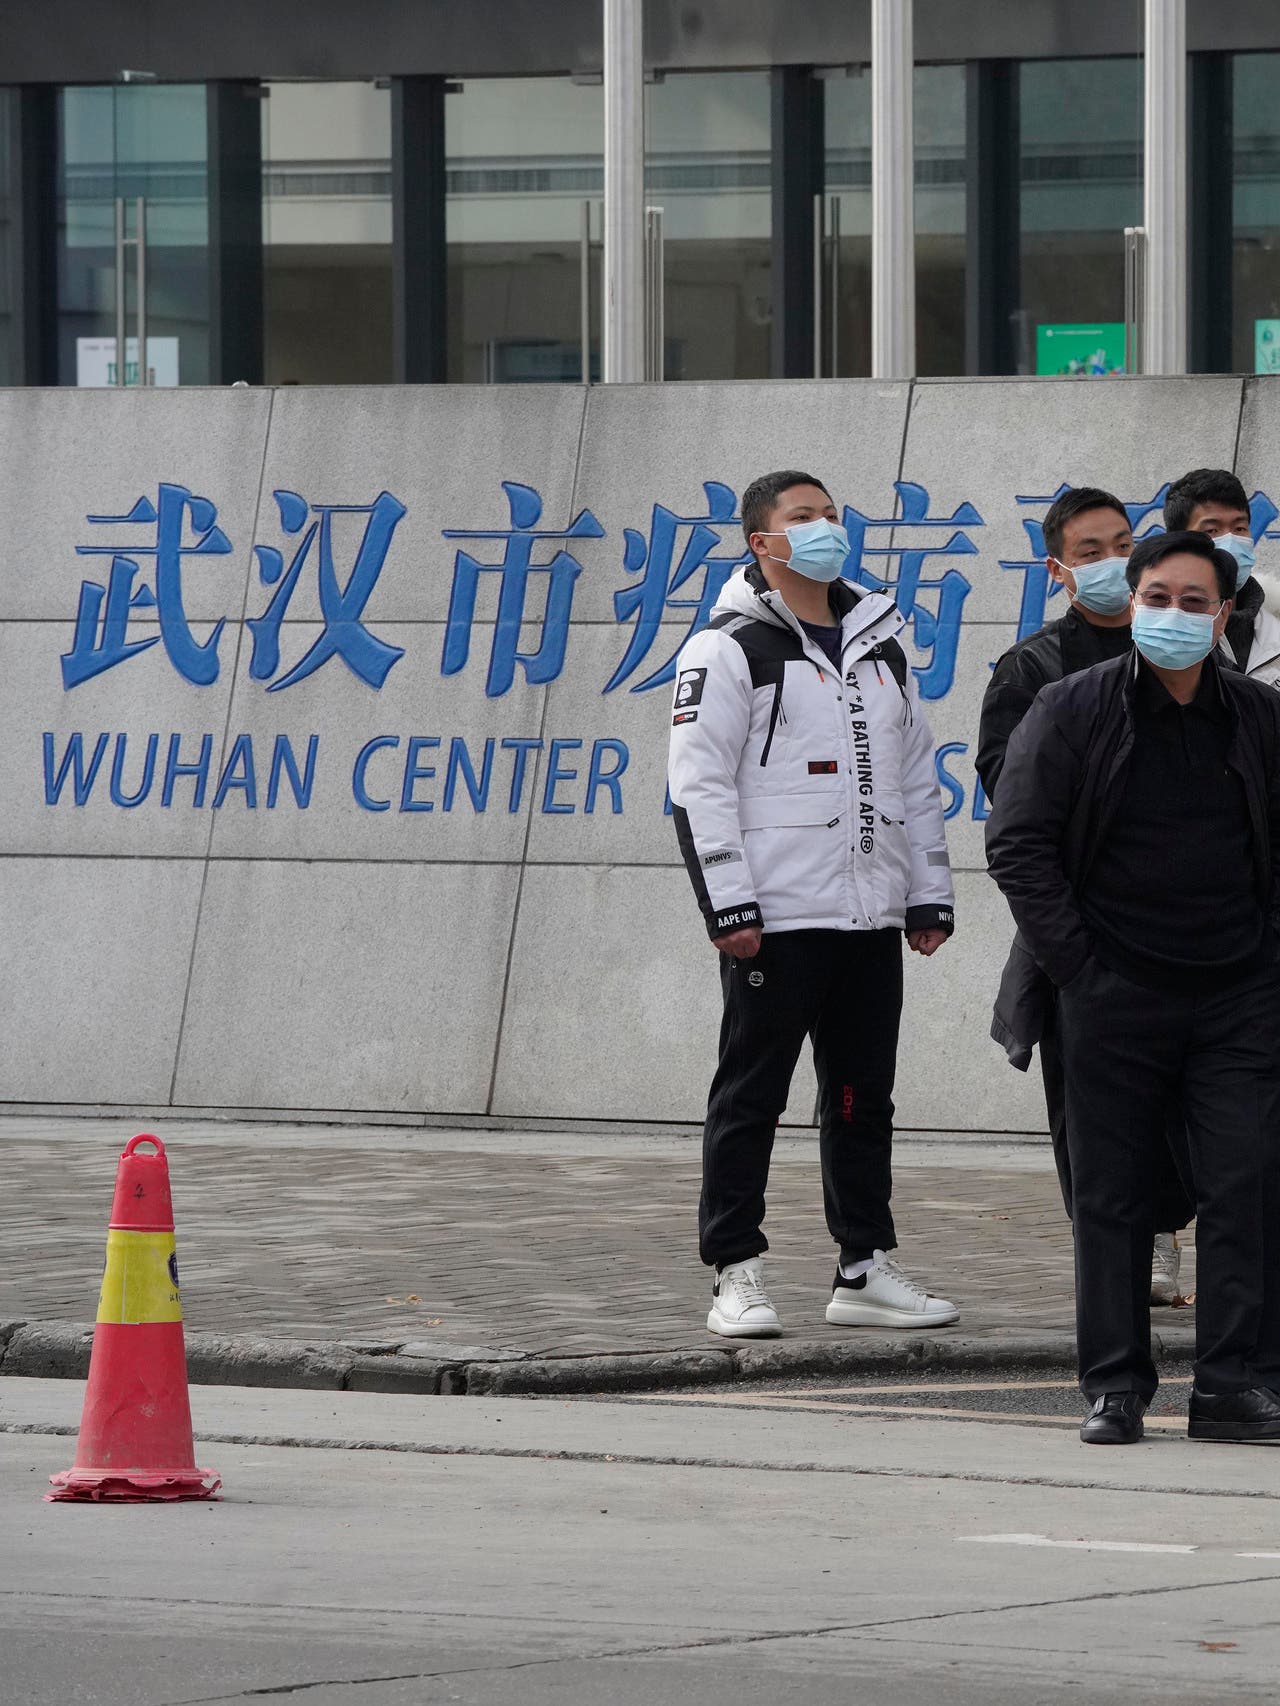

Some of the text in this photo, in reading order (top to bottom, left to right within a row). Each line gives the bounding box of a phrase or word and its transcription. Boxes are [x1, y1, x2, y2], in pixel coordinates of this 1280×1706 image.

[42, 732, 319, 810] WUHAN
[352, 735, 629, 815] CENTER
[852, 721, 873, 796] BATHING
[718, 909, 757, 928] AAPE UNI
